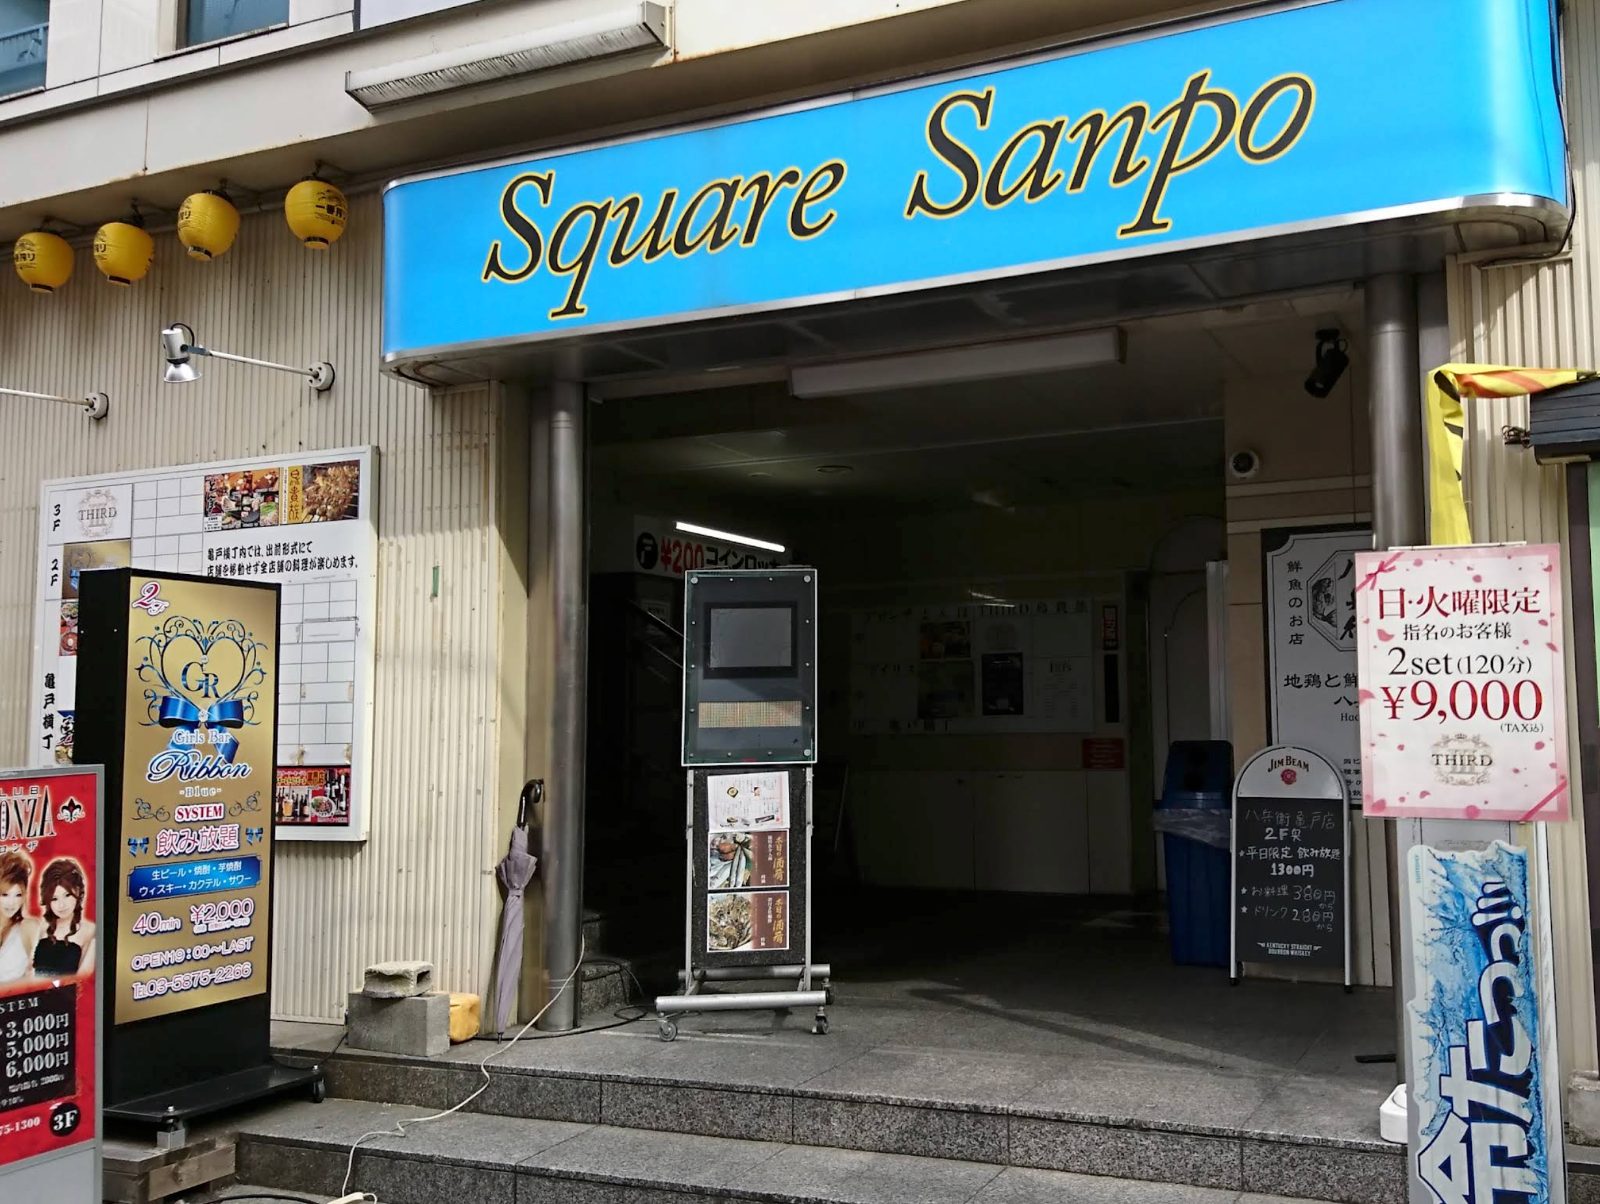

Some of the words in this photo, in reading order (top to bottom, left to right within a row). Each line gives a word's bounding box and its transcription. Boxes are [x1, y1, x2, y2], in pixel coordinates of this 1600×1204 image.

[484, 161, 847, 320] Square
[906, 69, 1317, 237] Sanpo
[78, 507, 118, 521] THIRD
[1287, 560, 1304, 645] 鮮魚のお店
[1403, 622, 1512, 640] 指名のお客様
[42, 672, 56, 750] 亀戸横丁
[1380, 680, 1542, 724] ¥9,000
[174, 729, 205, 744] Girls
[208, 729, 230, 743] Bar
[147, 750, 252, 782] Ribbon
[1431, 753, 1493, 766] THIRD
[175, 803, 224, 821] SYSTEM
[156, 824, 240, 856] 飲み放題
[1246, 846, 1293, 860] 平日限定
[1297, 847, 1341, 860] 飲み放題
[1270, 862, 1314, 878] 1300円
[133, 912, 182, 934] 40min
[6, 1013, 70, 1039] 3,000円
[6, 1032, 70, 1058] 5,000円
[6, 1051, 70, 1078] 6,000円
[53, 1110, 78, 1131] 3F
